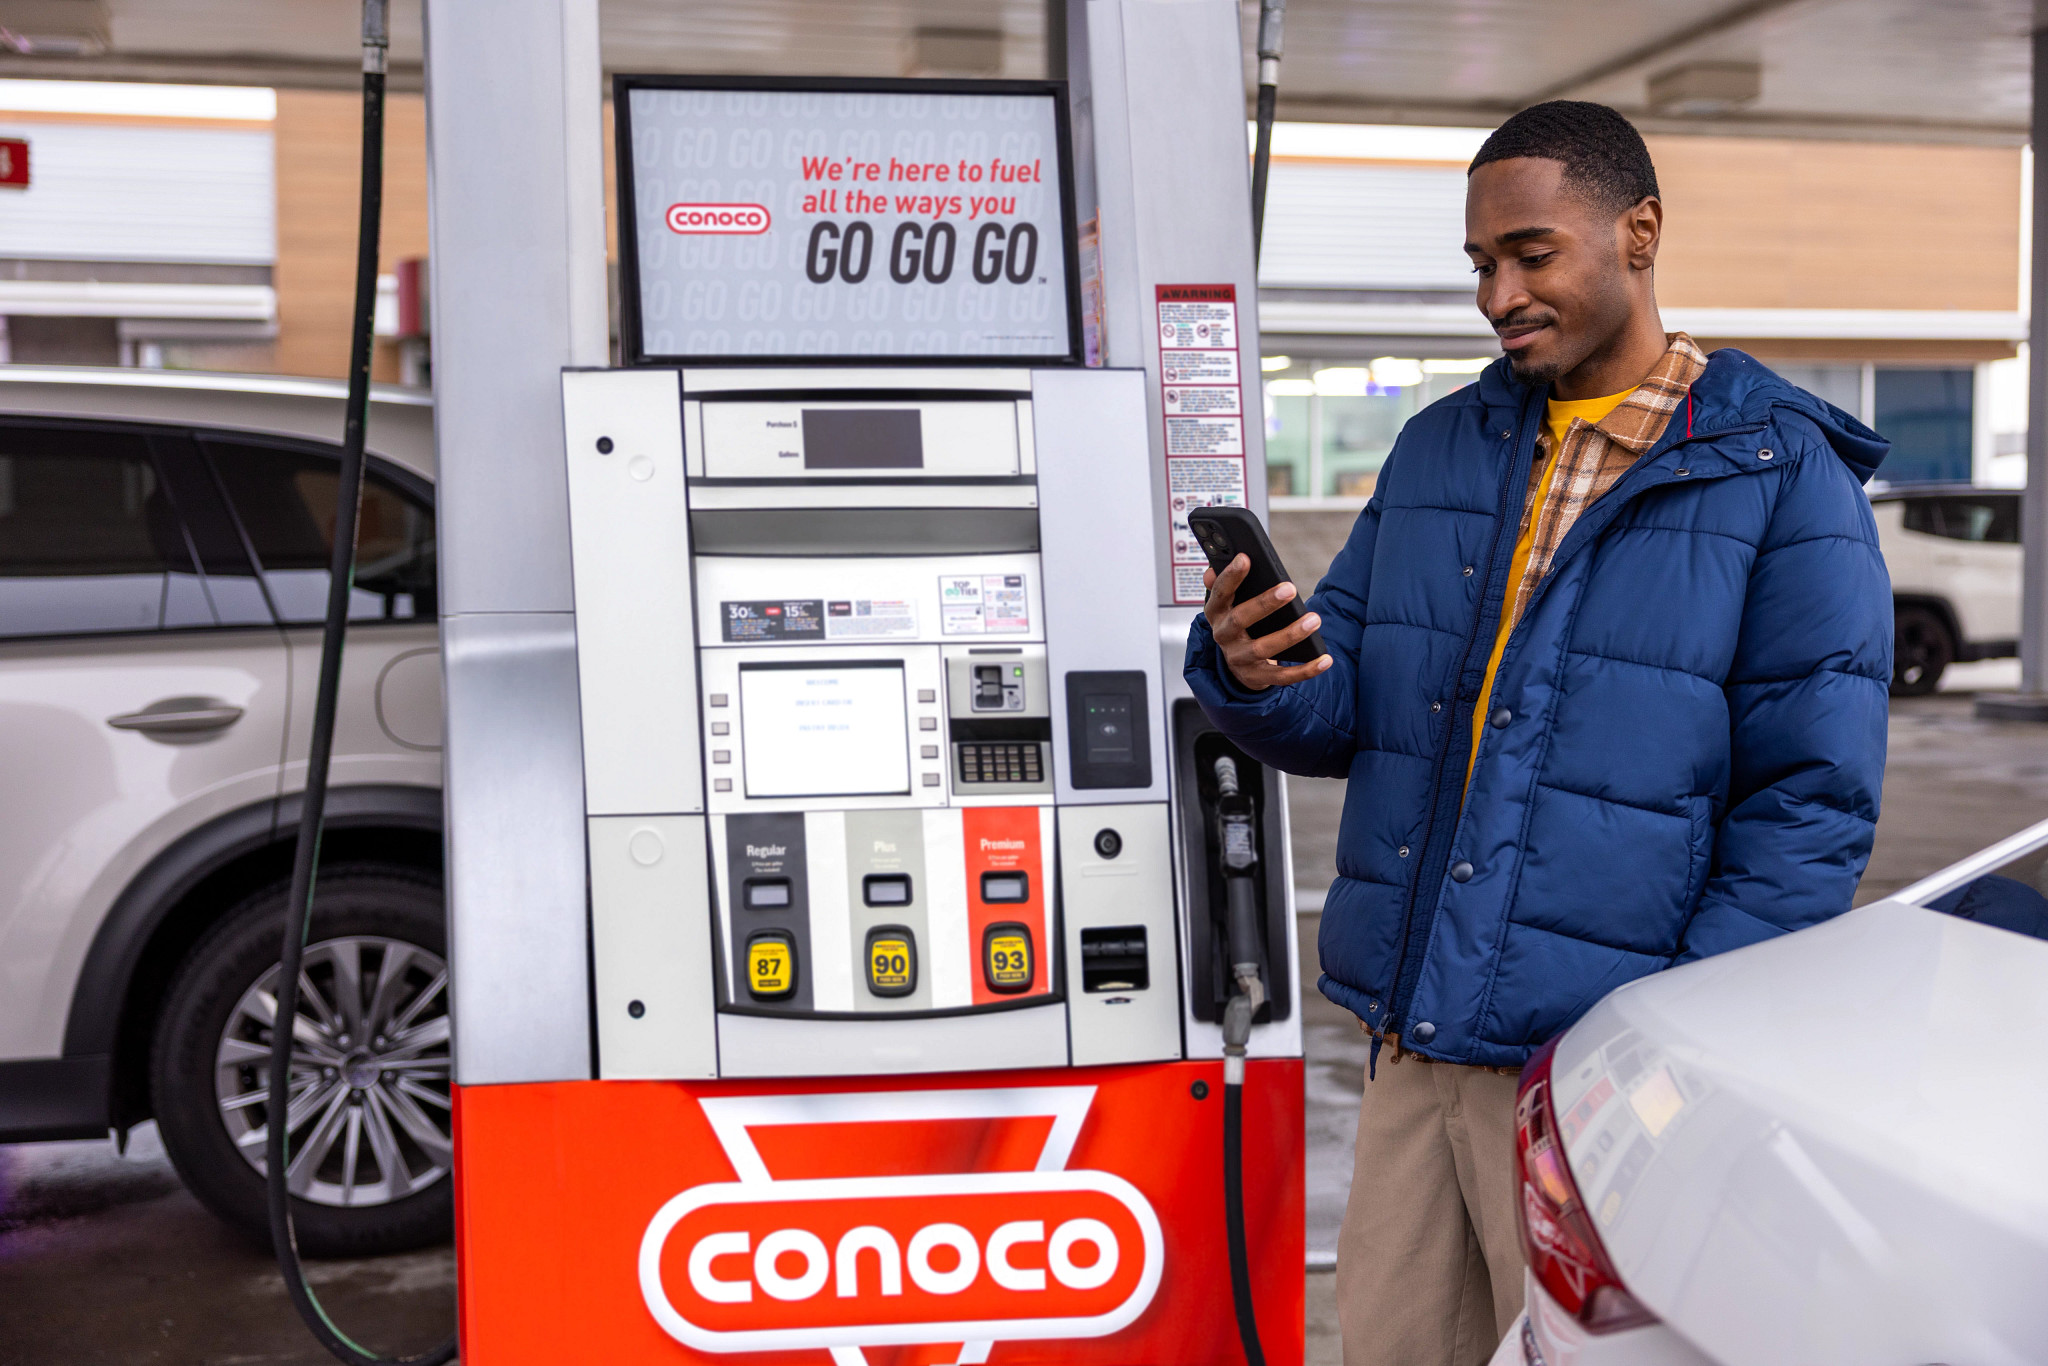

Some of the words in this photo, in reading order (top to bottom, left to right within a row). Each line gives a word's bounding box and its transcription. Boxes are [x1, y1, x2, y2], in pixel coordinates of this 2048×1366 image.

[673, 127, 718, 169] GO
[728, 127, 773, 170] GO
[802, 156, 881, 182] We're
[888, 157, 950, 183] here
[958, 160, 983, 183] to
[990, 158, 1041, 183] fuel
[802, 188, 837, 214] all
[845, 188, 888, 214] the
[895, 194, 962, 220] ways
[969, 195, 1016, 220] you
[805, 220, 873, 285] GO
[890, 221, 956, 285] GO
[972, 221, 1038, 285] GO
[682, 280, 727, 321] GO
[738, 280, 782, 321] GO
[791, 280, 836, 321] GO
[846, 281, 890, 322] GO
[902, 282, 945, 322] GO
[957, 282, 998, 322] GO
[1009, 282, 1051, 322] GO
[1171, 289, 1231, 299] WARNING
[960, 588, 979, 596] TIER
[746, 844, 787, 859] Regular
[873, 841, 896, 853] Plus
[980, 838, 1025, 851] Premium
[757, 958, 781, 976] 87
[875, 954, 906, 974] 90
[994, 951, 1024, 971] 93
